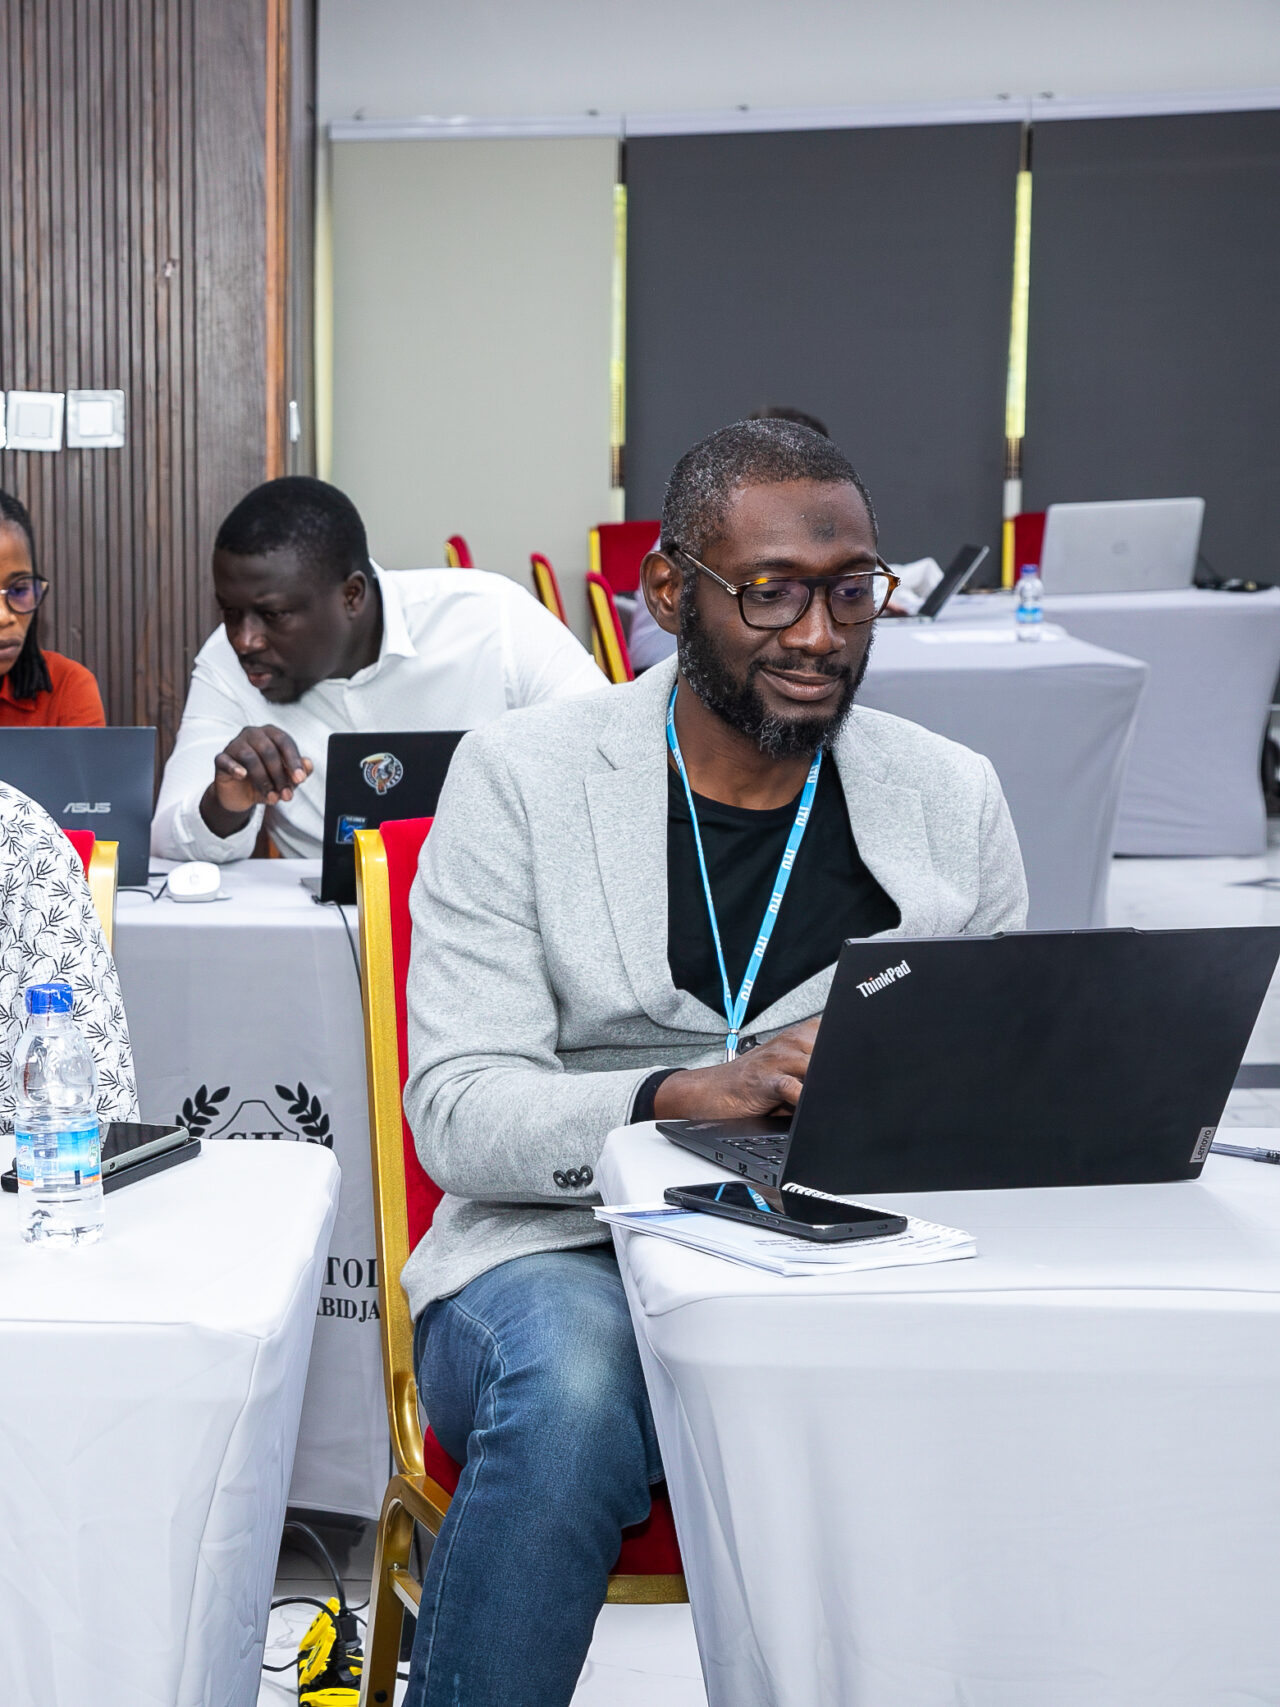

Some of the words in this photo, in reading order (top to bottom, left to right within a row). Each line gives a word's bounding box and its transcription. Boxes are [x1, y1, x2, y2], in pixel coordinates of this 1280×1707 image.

[806, 765, 820, 784] ITU
[62, 802, 112, 814] ASUS
[795, 806, 810, 827] ITU
[782, 849, 798, 870] ITU
[768, 892, 784, 914] ITU
[754, 936, 769, 958] ITU
[855, 959, 912, 998] ThinkPad
[741, 979, 754, 1001] ITU
[1193, 1129, 1212, 1160] Lenovo
[317, 1297, 381, 1323] BIDJA
